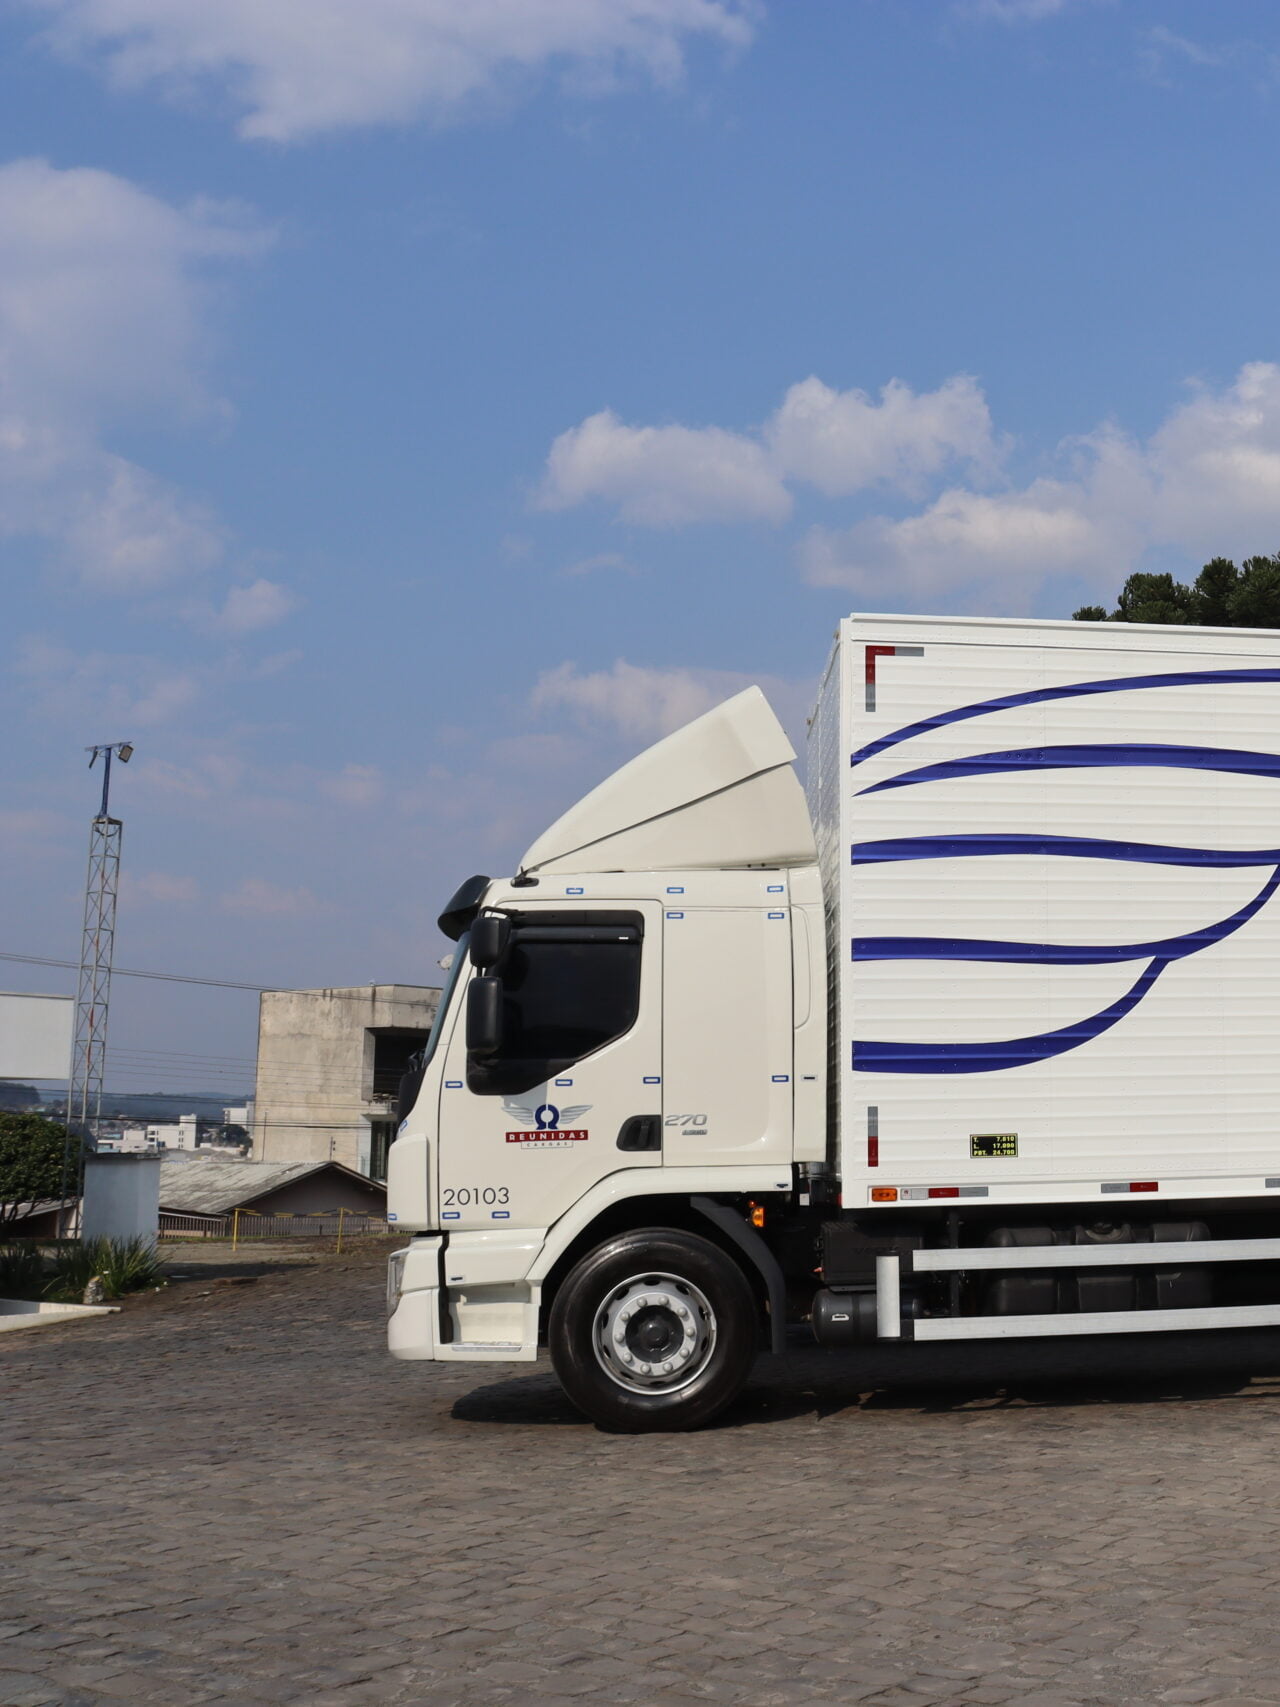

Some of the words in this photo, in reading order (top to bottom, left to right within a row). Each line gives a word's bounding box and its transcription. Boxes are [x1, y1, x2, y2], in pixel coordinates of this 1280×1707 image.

[665, 1114, 708, 1126] 270
[509, 1132, 585, 1141] REUNIDAS
[443, 1187, 509, 1205] 20103
